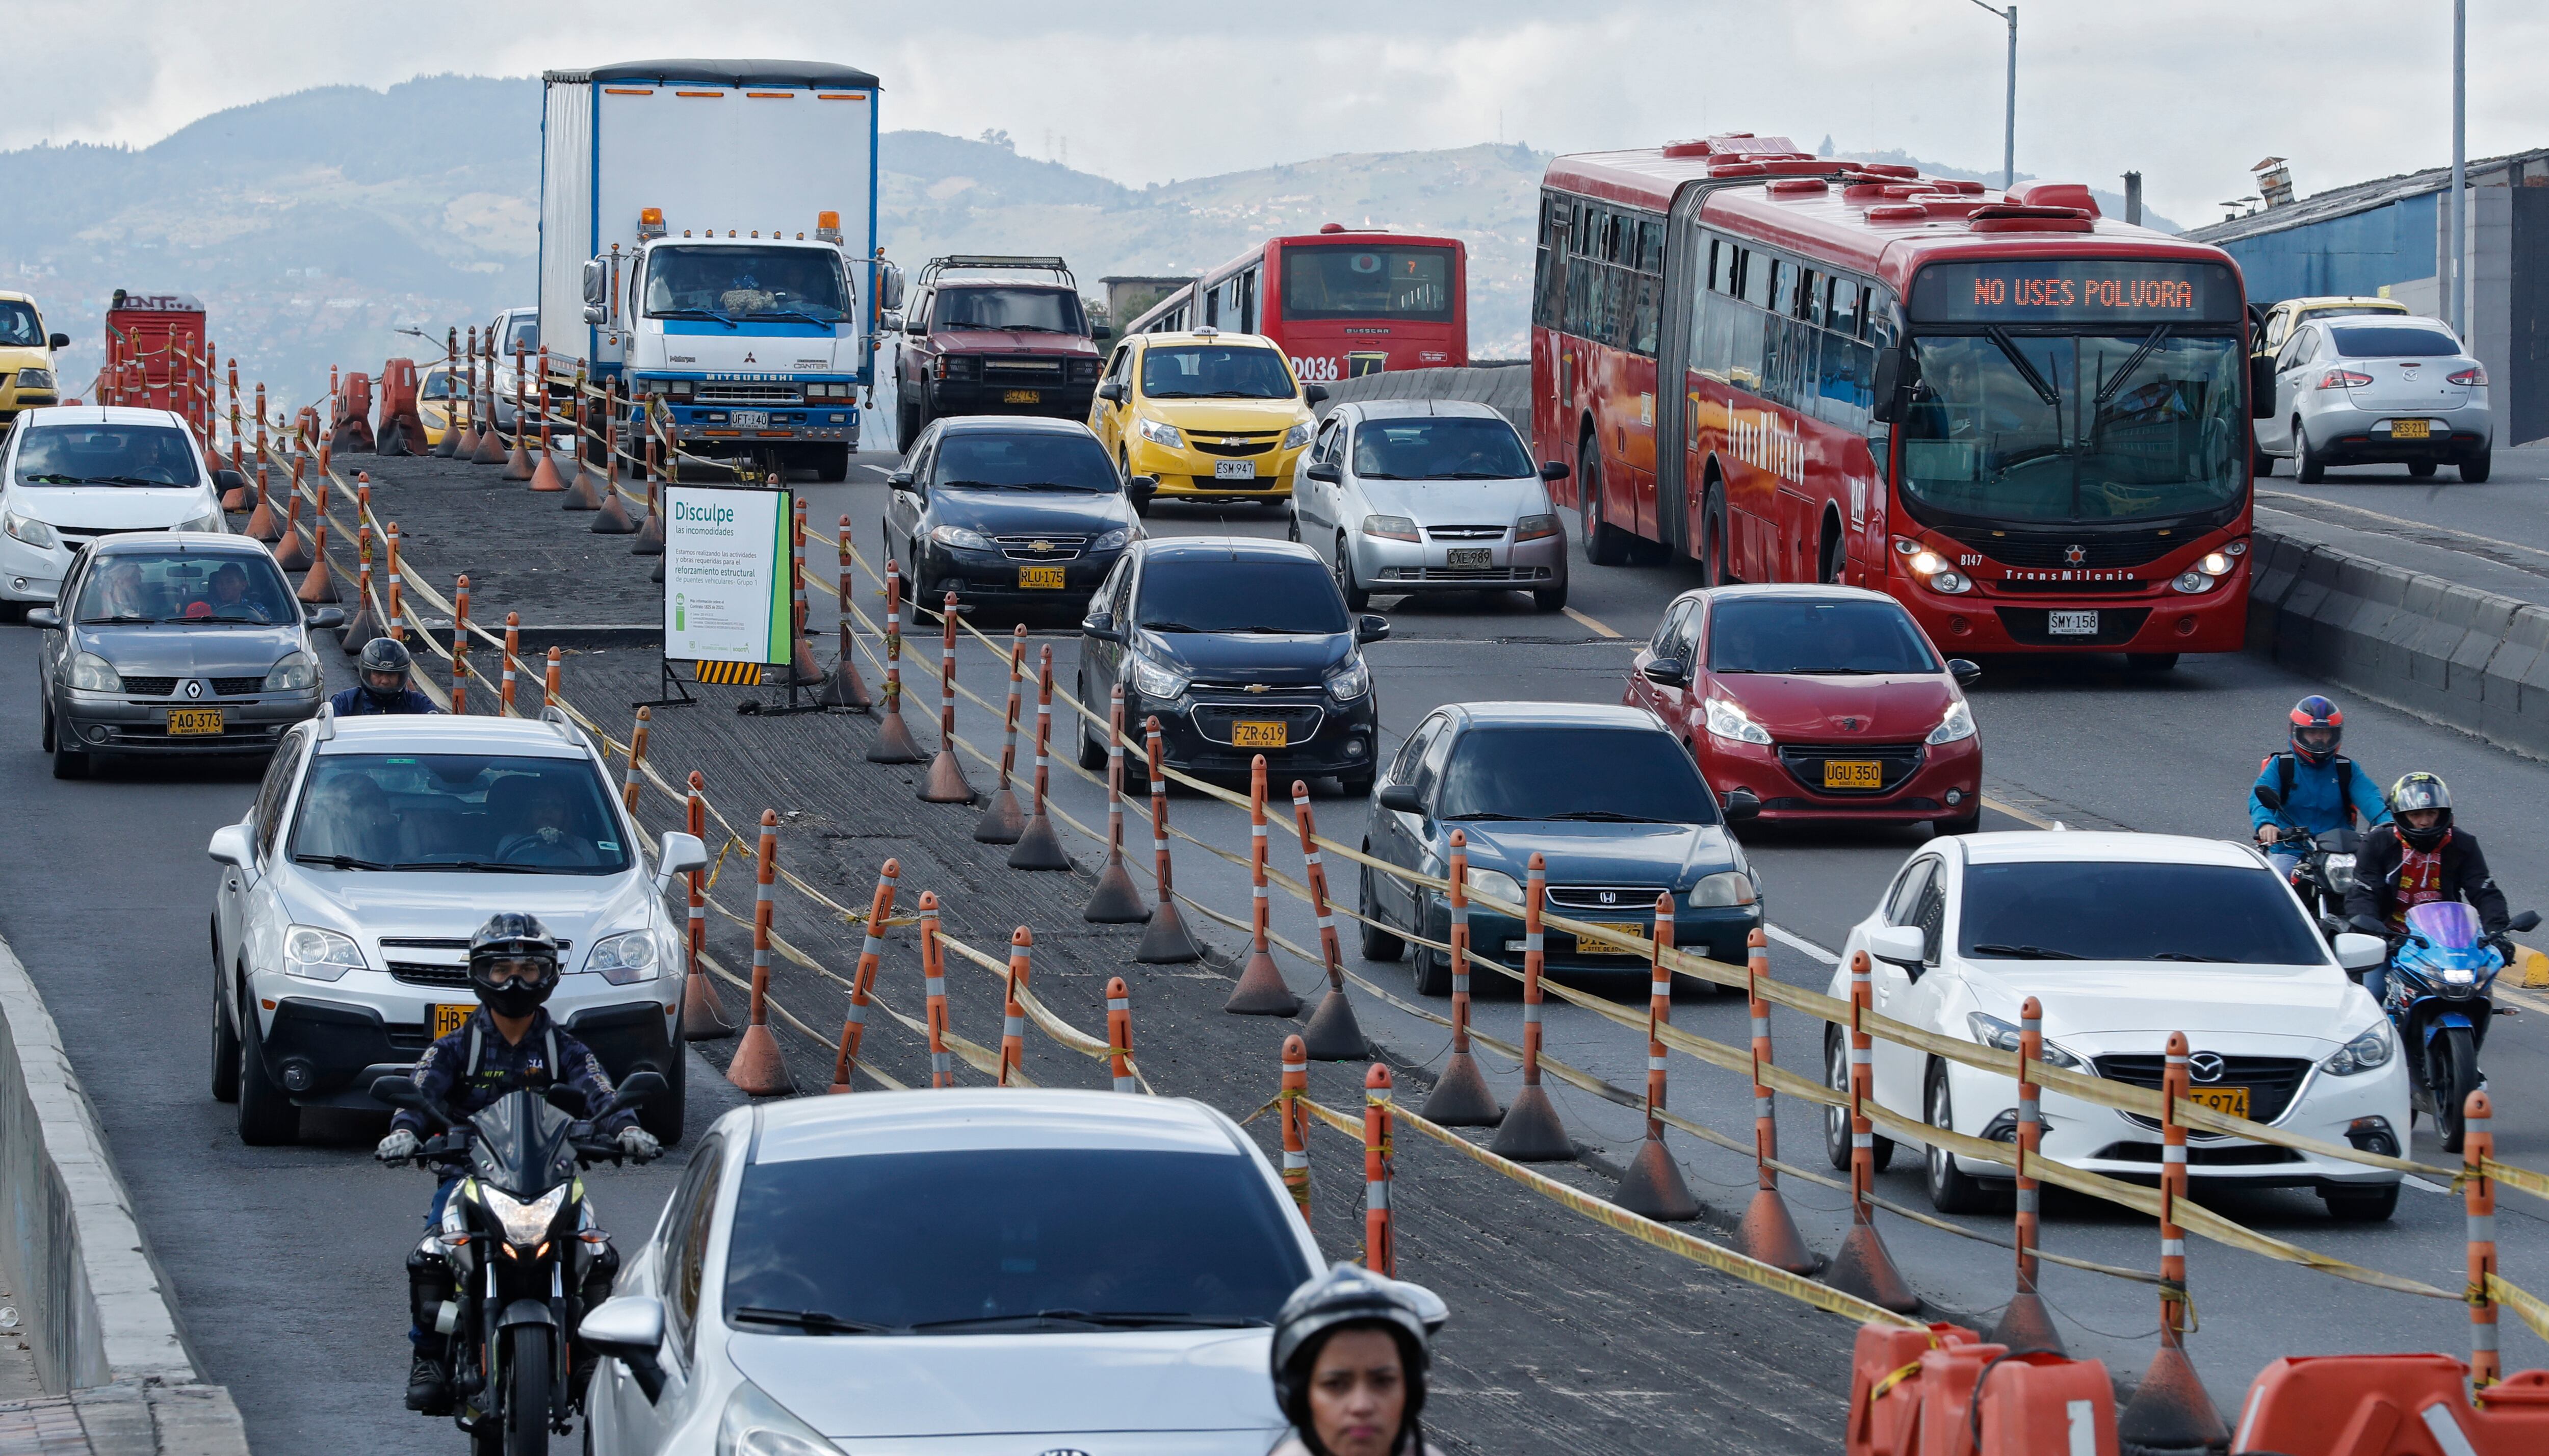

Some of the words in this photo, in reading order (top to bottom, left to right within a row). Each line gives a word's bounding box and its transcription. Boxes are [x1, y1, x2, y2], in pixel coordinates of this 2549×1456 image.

[1974, 278, 2005, 305] NO
[2014, 279, 2075, 306] USES
[2085, 279, 2192, 307] POLVORA
[1291, 357, 1338, 380] D036
[1728, 399, 1804, 485] TransMilenio
[1851, 478, 1866, 521] B147
[675, 501, 734, 527] Disculpe
[675, 525, 685, 534] las
[686, 526, 734, 536] incomodidades
[675, 565, 719, 576] reforzamiento
[720, 568, 756, 577] estructural
[1961, 554, 1983, 566] B147
[2006, 569, 2134, 581] TransMilenio
